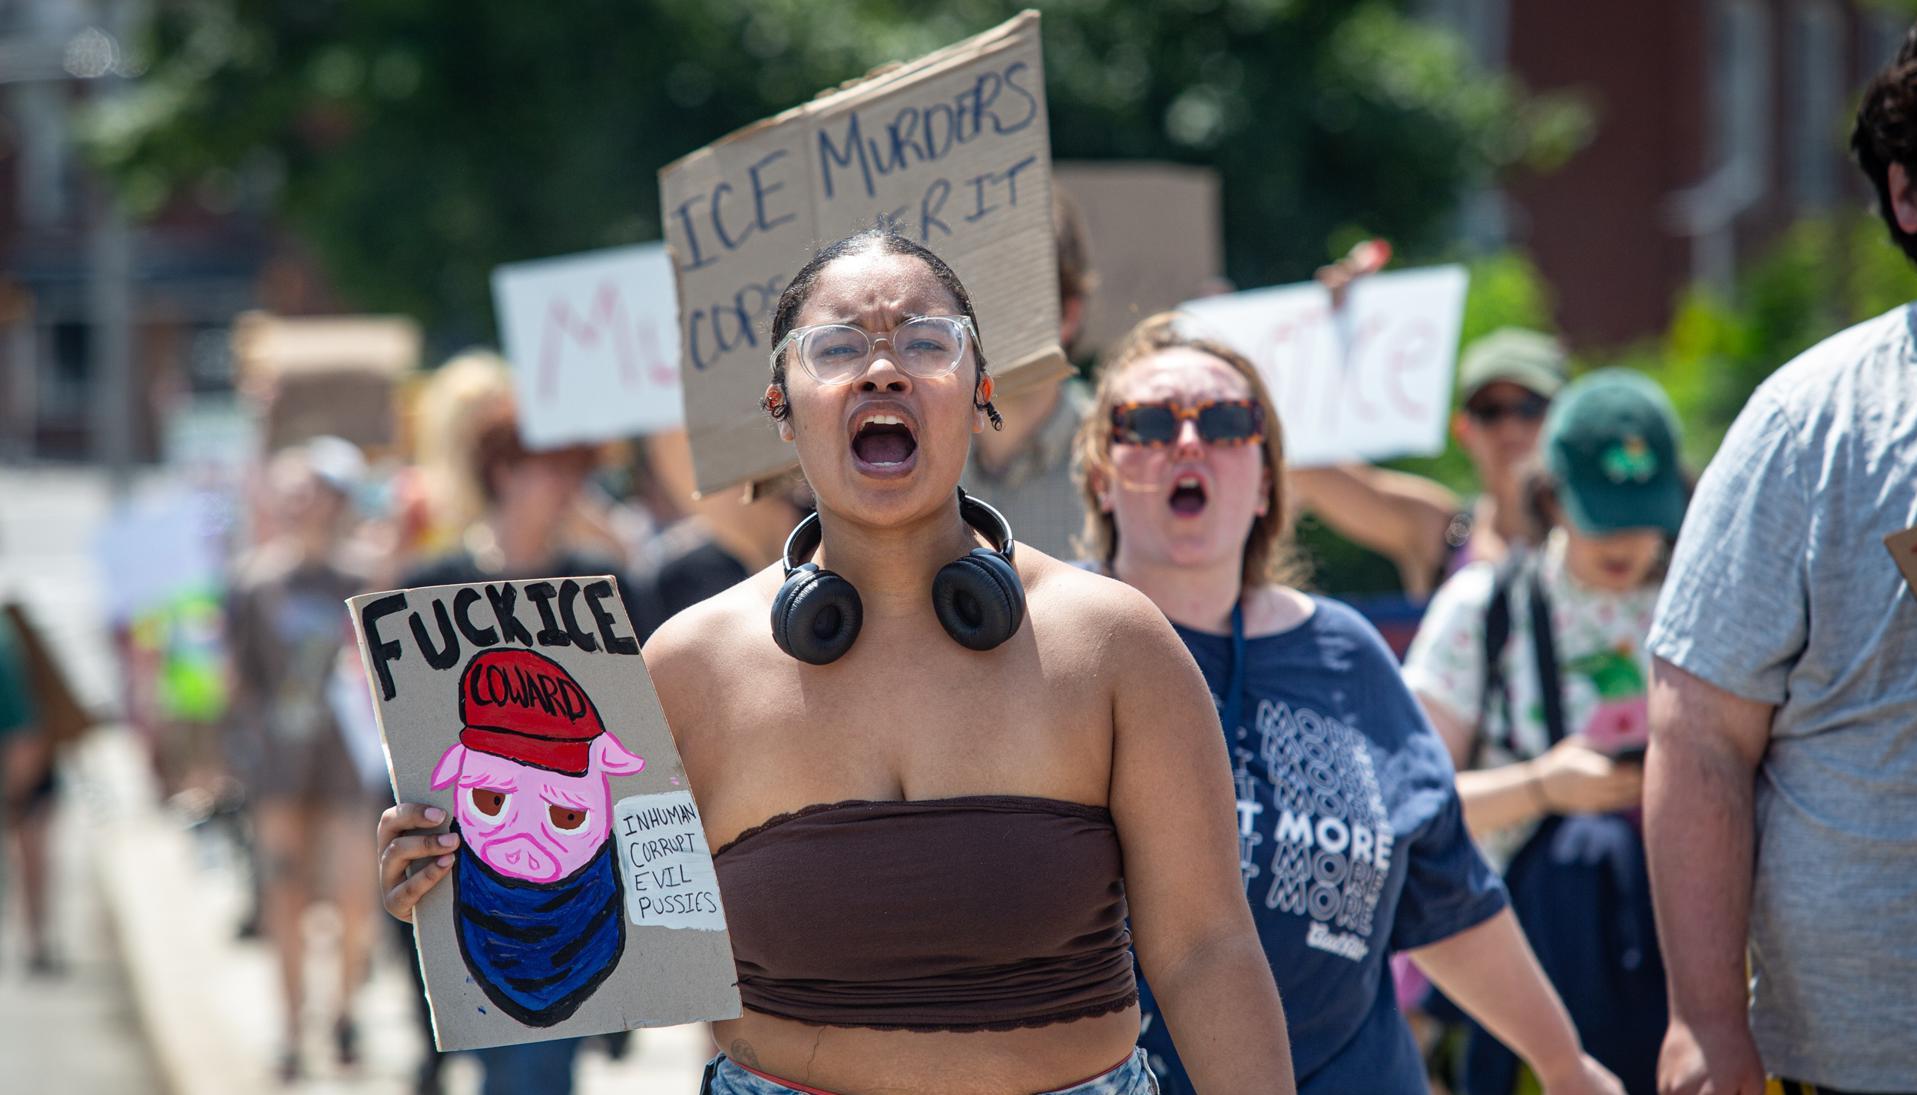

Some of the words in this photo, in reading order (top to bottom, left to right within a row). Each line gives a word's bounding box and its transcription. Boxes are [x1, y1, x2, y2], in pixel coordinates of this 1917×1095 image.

[670, 149, 796, 272] ICE
[817, 61, 1037, 200] MURDERS
[964, 154, 1037, 223] IT
[362, 581, 533, 701] FUCK
[524, 579, 641, 656] ICE
[470, 663, 587, 724] COWARD
[623, 802, 697, 836] INHUMAN
[1274, 809, 1395, 870] MORE
[630, 832, 695, 868] CORRUPT
[635, 864, 692, 891] EVIL
[638, 891, 717, 919] PUSSIES
